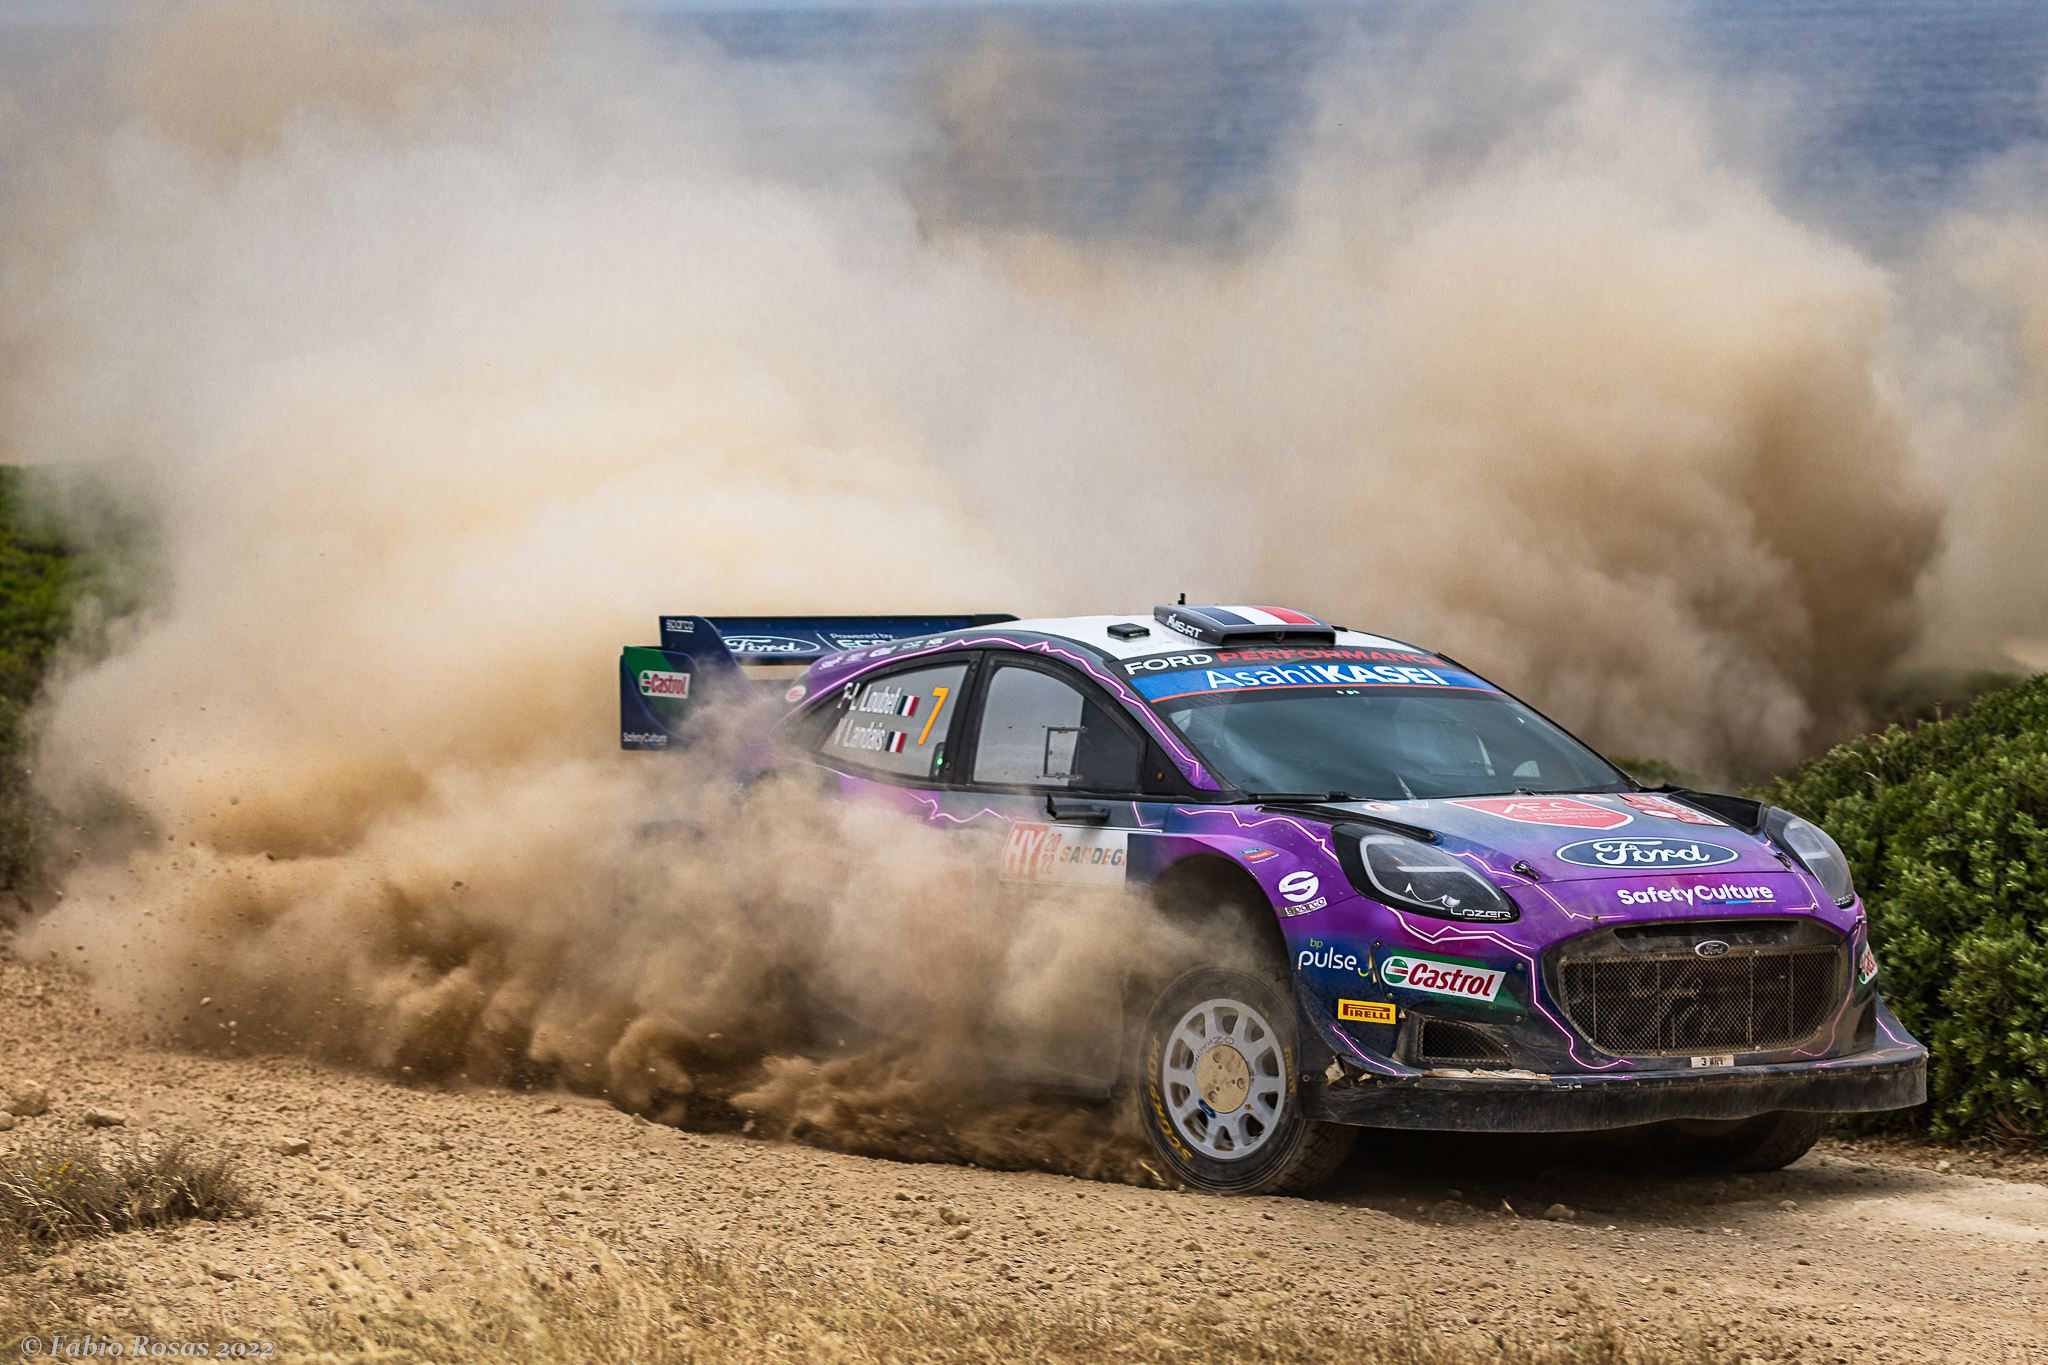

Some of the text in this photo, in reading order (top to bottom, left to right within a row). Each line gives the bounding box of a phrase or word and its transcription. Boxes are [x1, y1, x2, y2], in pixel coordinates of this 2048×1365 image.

[723, 639, 802, 652] Ford
[1124, 649, 1448, 676] FORD PERFORMANCE
[650, 673, 687, 695] Castrol
[917, 687, 950, 745] 7
[1004, 829, 1046, 875] HY
[1060, 845, 1128, 867] SARDEG
[1592, 840, 1711, 864] Ford
[1617, 884, 1774, 906] SafetyCulture
[1310, 938, 1323, 949] bp
[1298, 947, 1358, 971] pulse
[1408, 963, 1496, 998] Castrol
[1342, 1003, 1391, 1020] PIRELLI
